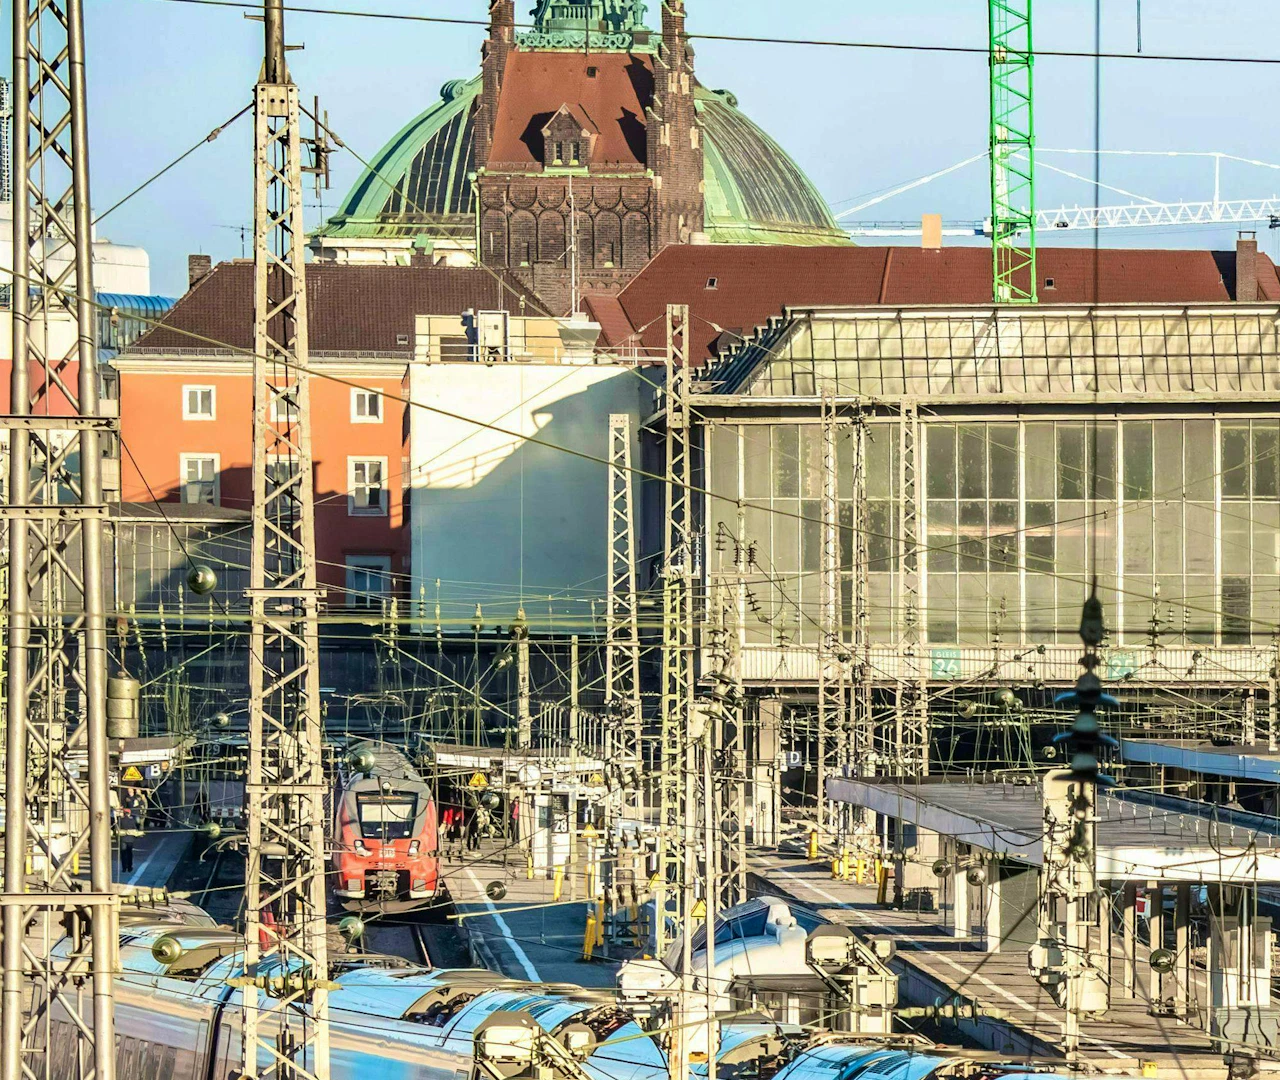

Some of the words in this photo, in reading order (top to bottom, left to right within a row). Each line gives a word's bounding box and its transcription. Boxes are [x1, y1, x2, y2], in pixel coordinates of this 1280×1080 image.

[936, 660, 958, 676] 26
[791, 752, 799, 763] D
[151, 764, 160, 776] B
[555, 821, 568, 832] 28
